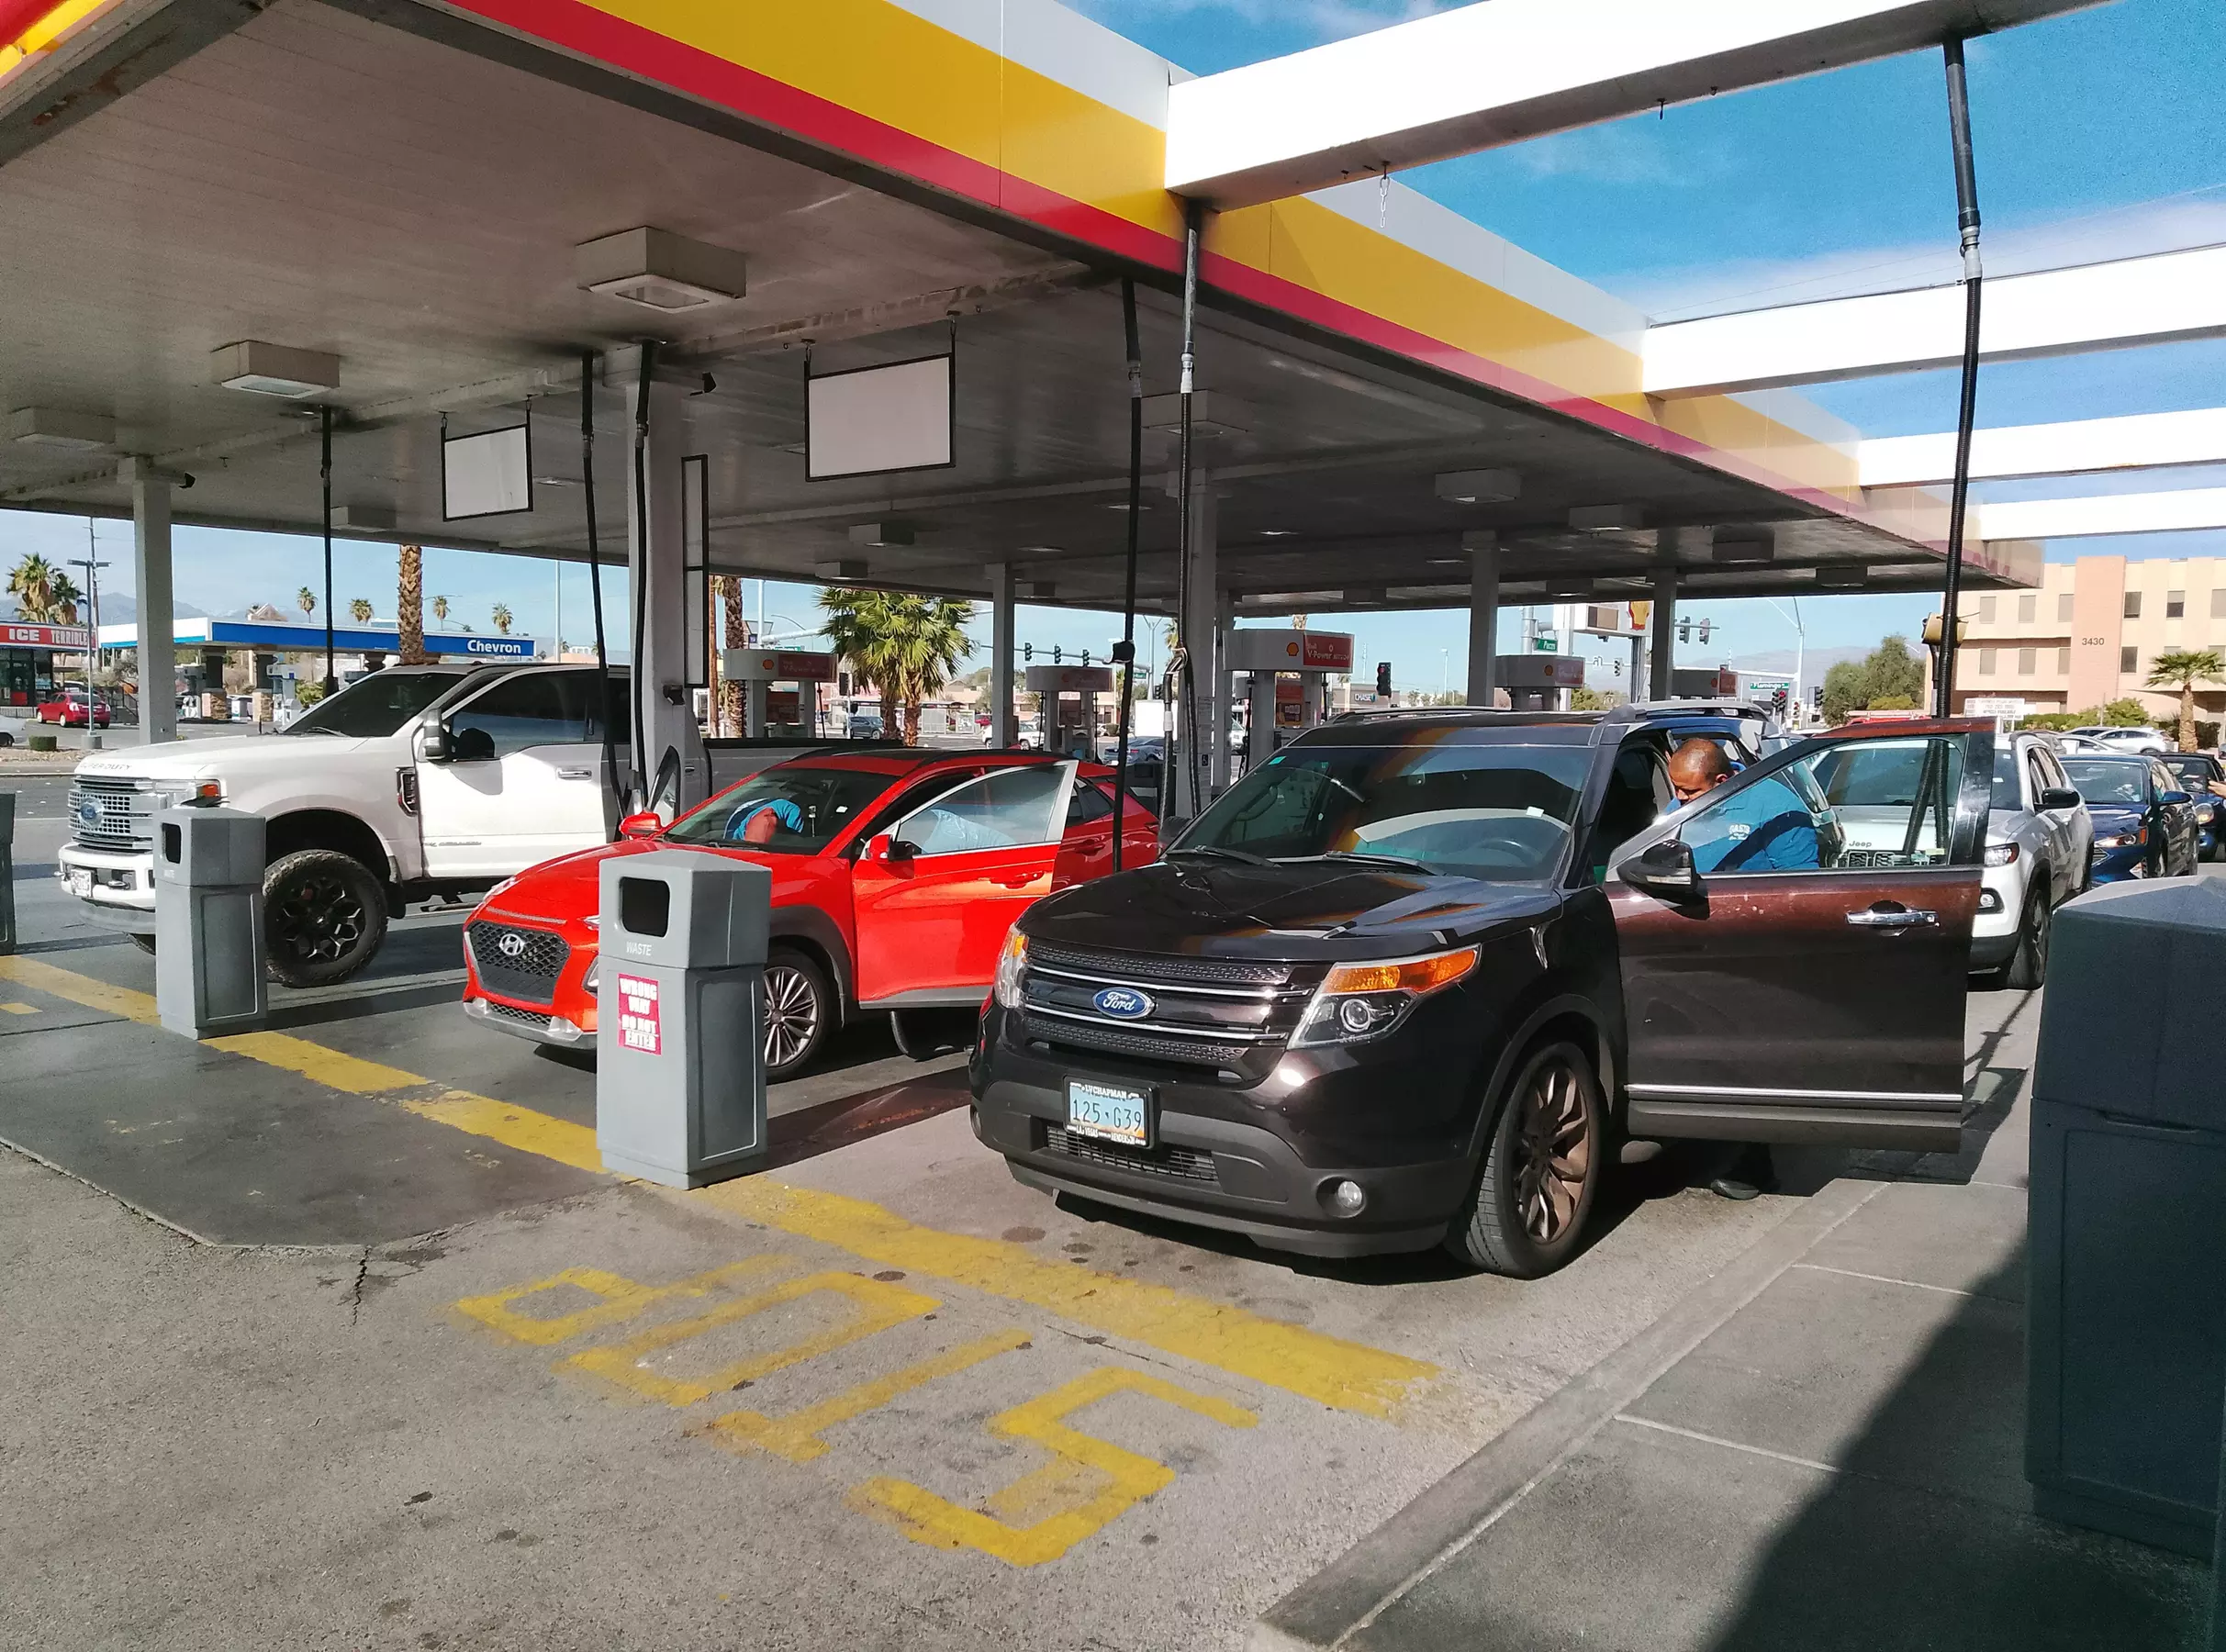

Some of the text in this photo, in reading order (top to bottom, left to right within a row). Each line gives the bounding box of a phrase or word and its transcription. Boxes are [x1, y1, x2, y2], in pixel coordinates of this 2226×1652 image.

[9, 629, 39, 642] ICE
[467, 640, 521, 653] Chevron
[1355, 693, 1371, 701] CHASE
[626, 942, 652, 955] WASTE
[619, 978, 657, 1000] WRONG
[628, 995, 651, 1015] WAY
[1102, 991, 1135, 1012] Ford
[625, 1030, 656, 1051] ENTER
[1073, 1099, 1142, 1132] 125 G39
[1085, 1127, 1099, 1138] VEGAS
[454, 1257, 1259, 1567] STOP
